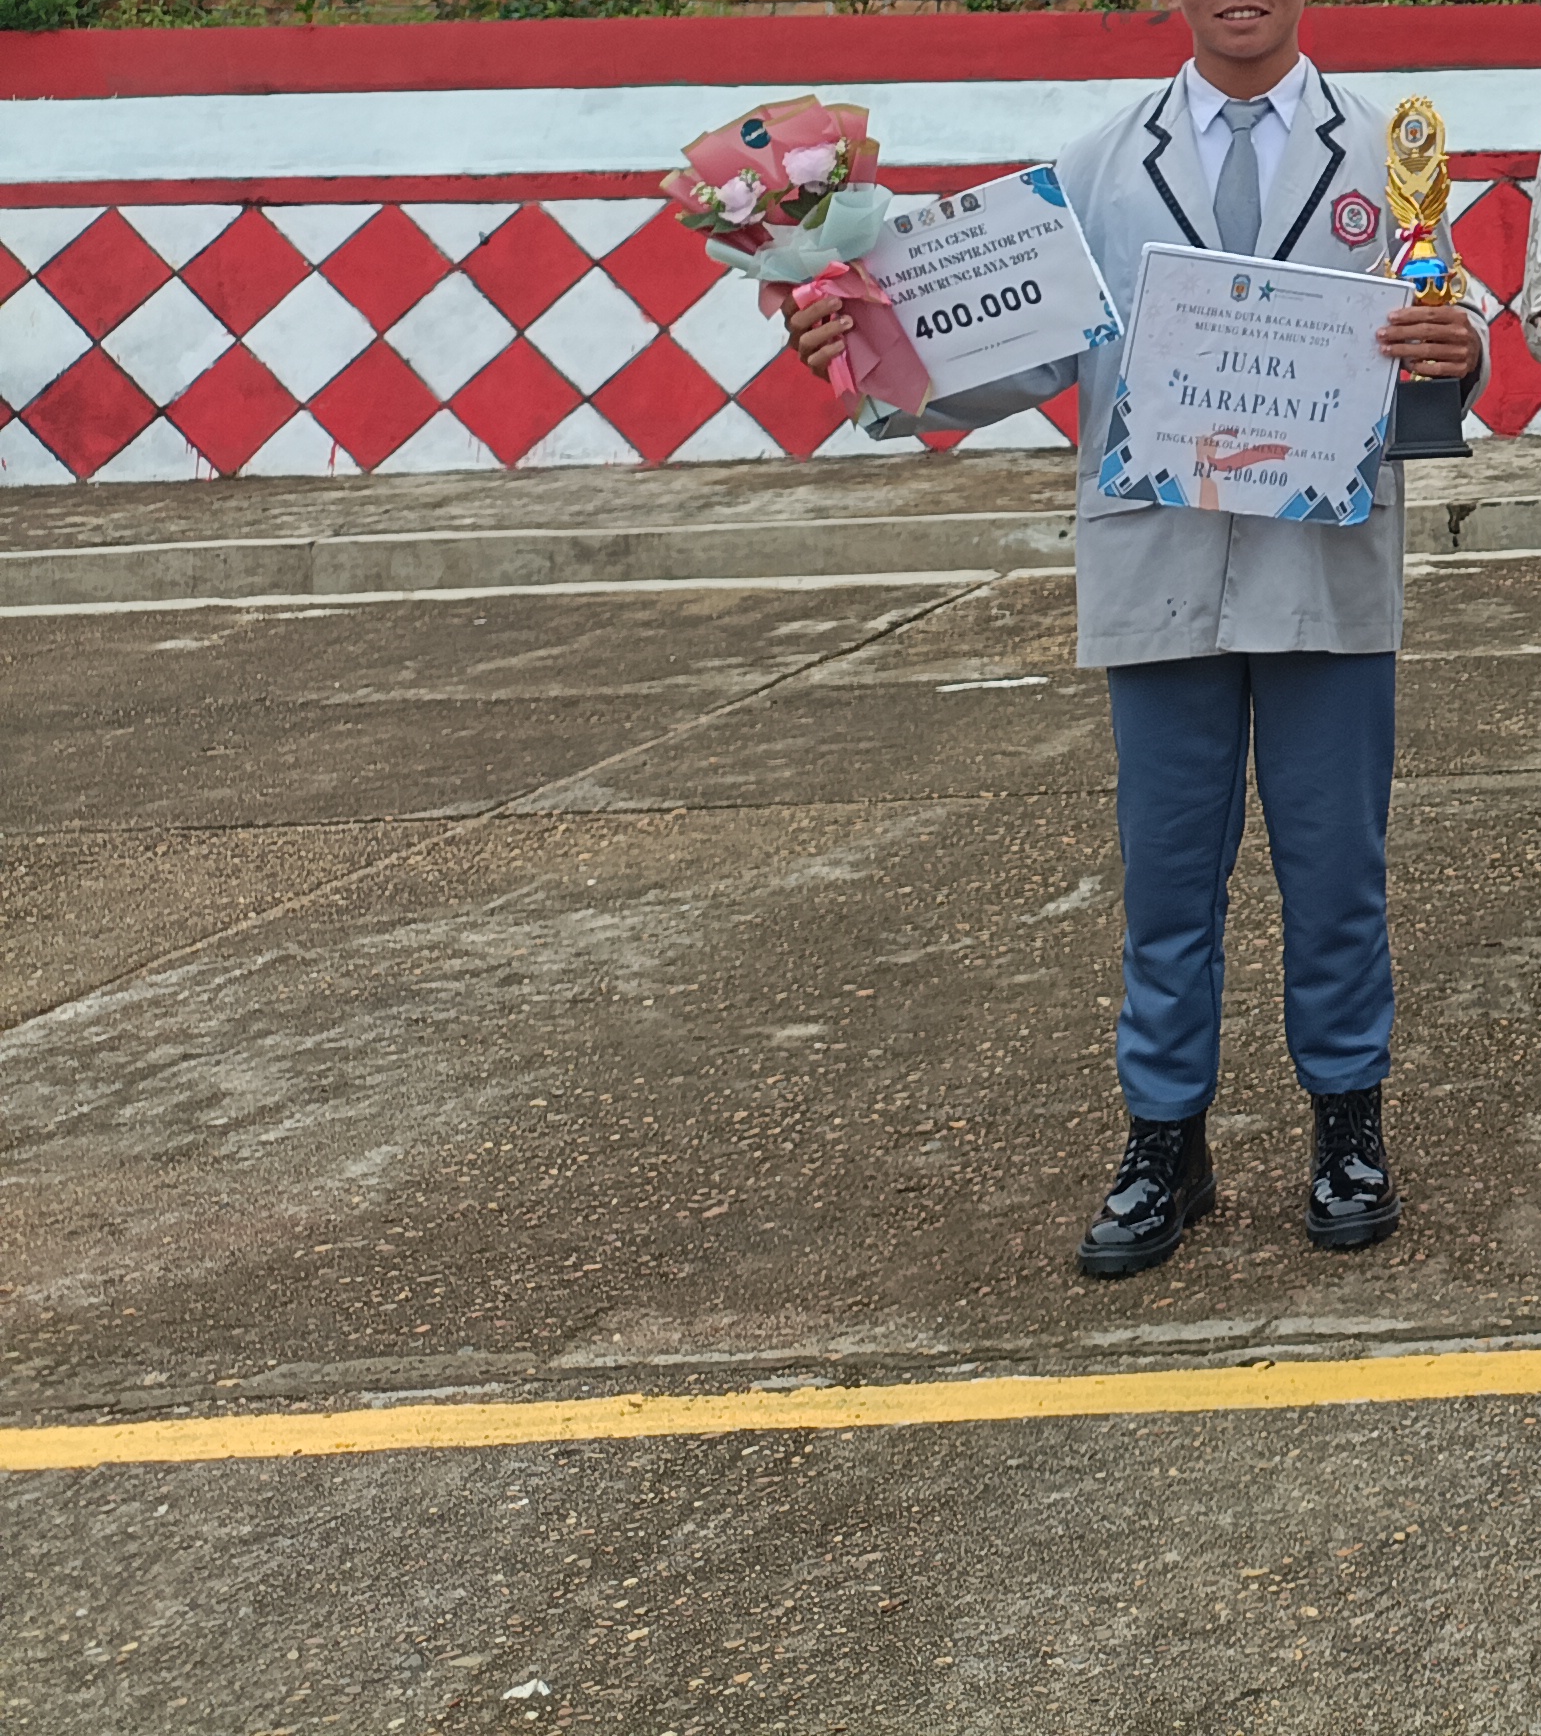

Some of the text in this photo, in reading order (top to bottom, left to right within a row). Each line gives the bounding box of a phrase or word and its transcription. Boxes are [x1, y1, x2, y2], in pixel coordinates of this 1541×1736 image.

[895, 261, 938, 284] MEDIA
[938, 233, 1018, 269] INSPIRATOR
[1017, 218, 1064, 242] PUTRA
[908, 239, 945, 260] DUTA
[917, 269, 973, 298] MURUNG
[972, 258, 1010, 279] RAYA
[1009, 247, 1039, 266] 2025
[915, 279, 1043, 339] 400.000
[1175, 302, 1232, 319] PEMILIHAN
[1234, 311, 1262, 323] DUTA
[1264, 315, 1292, 328] BACA
[1195, 321, 1239, 336] MURUNG
[1241, 327, 1270, 340] RAYA
[1272, 331, 1306, 344] TAHUN
[1216, 350, 1297, 379] JUARA
[1180, 385, 1330, 423] HARAPAN II
[1156, 431, 1337, 462] TINGKAT SEKOLAH MENENGAH ATAS
[1211, 423, 1288, 441] LOMBA PIDATO
[1192, 460, 1289, 487] RP 200.000
